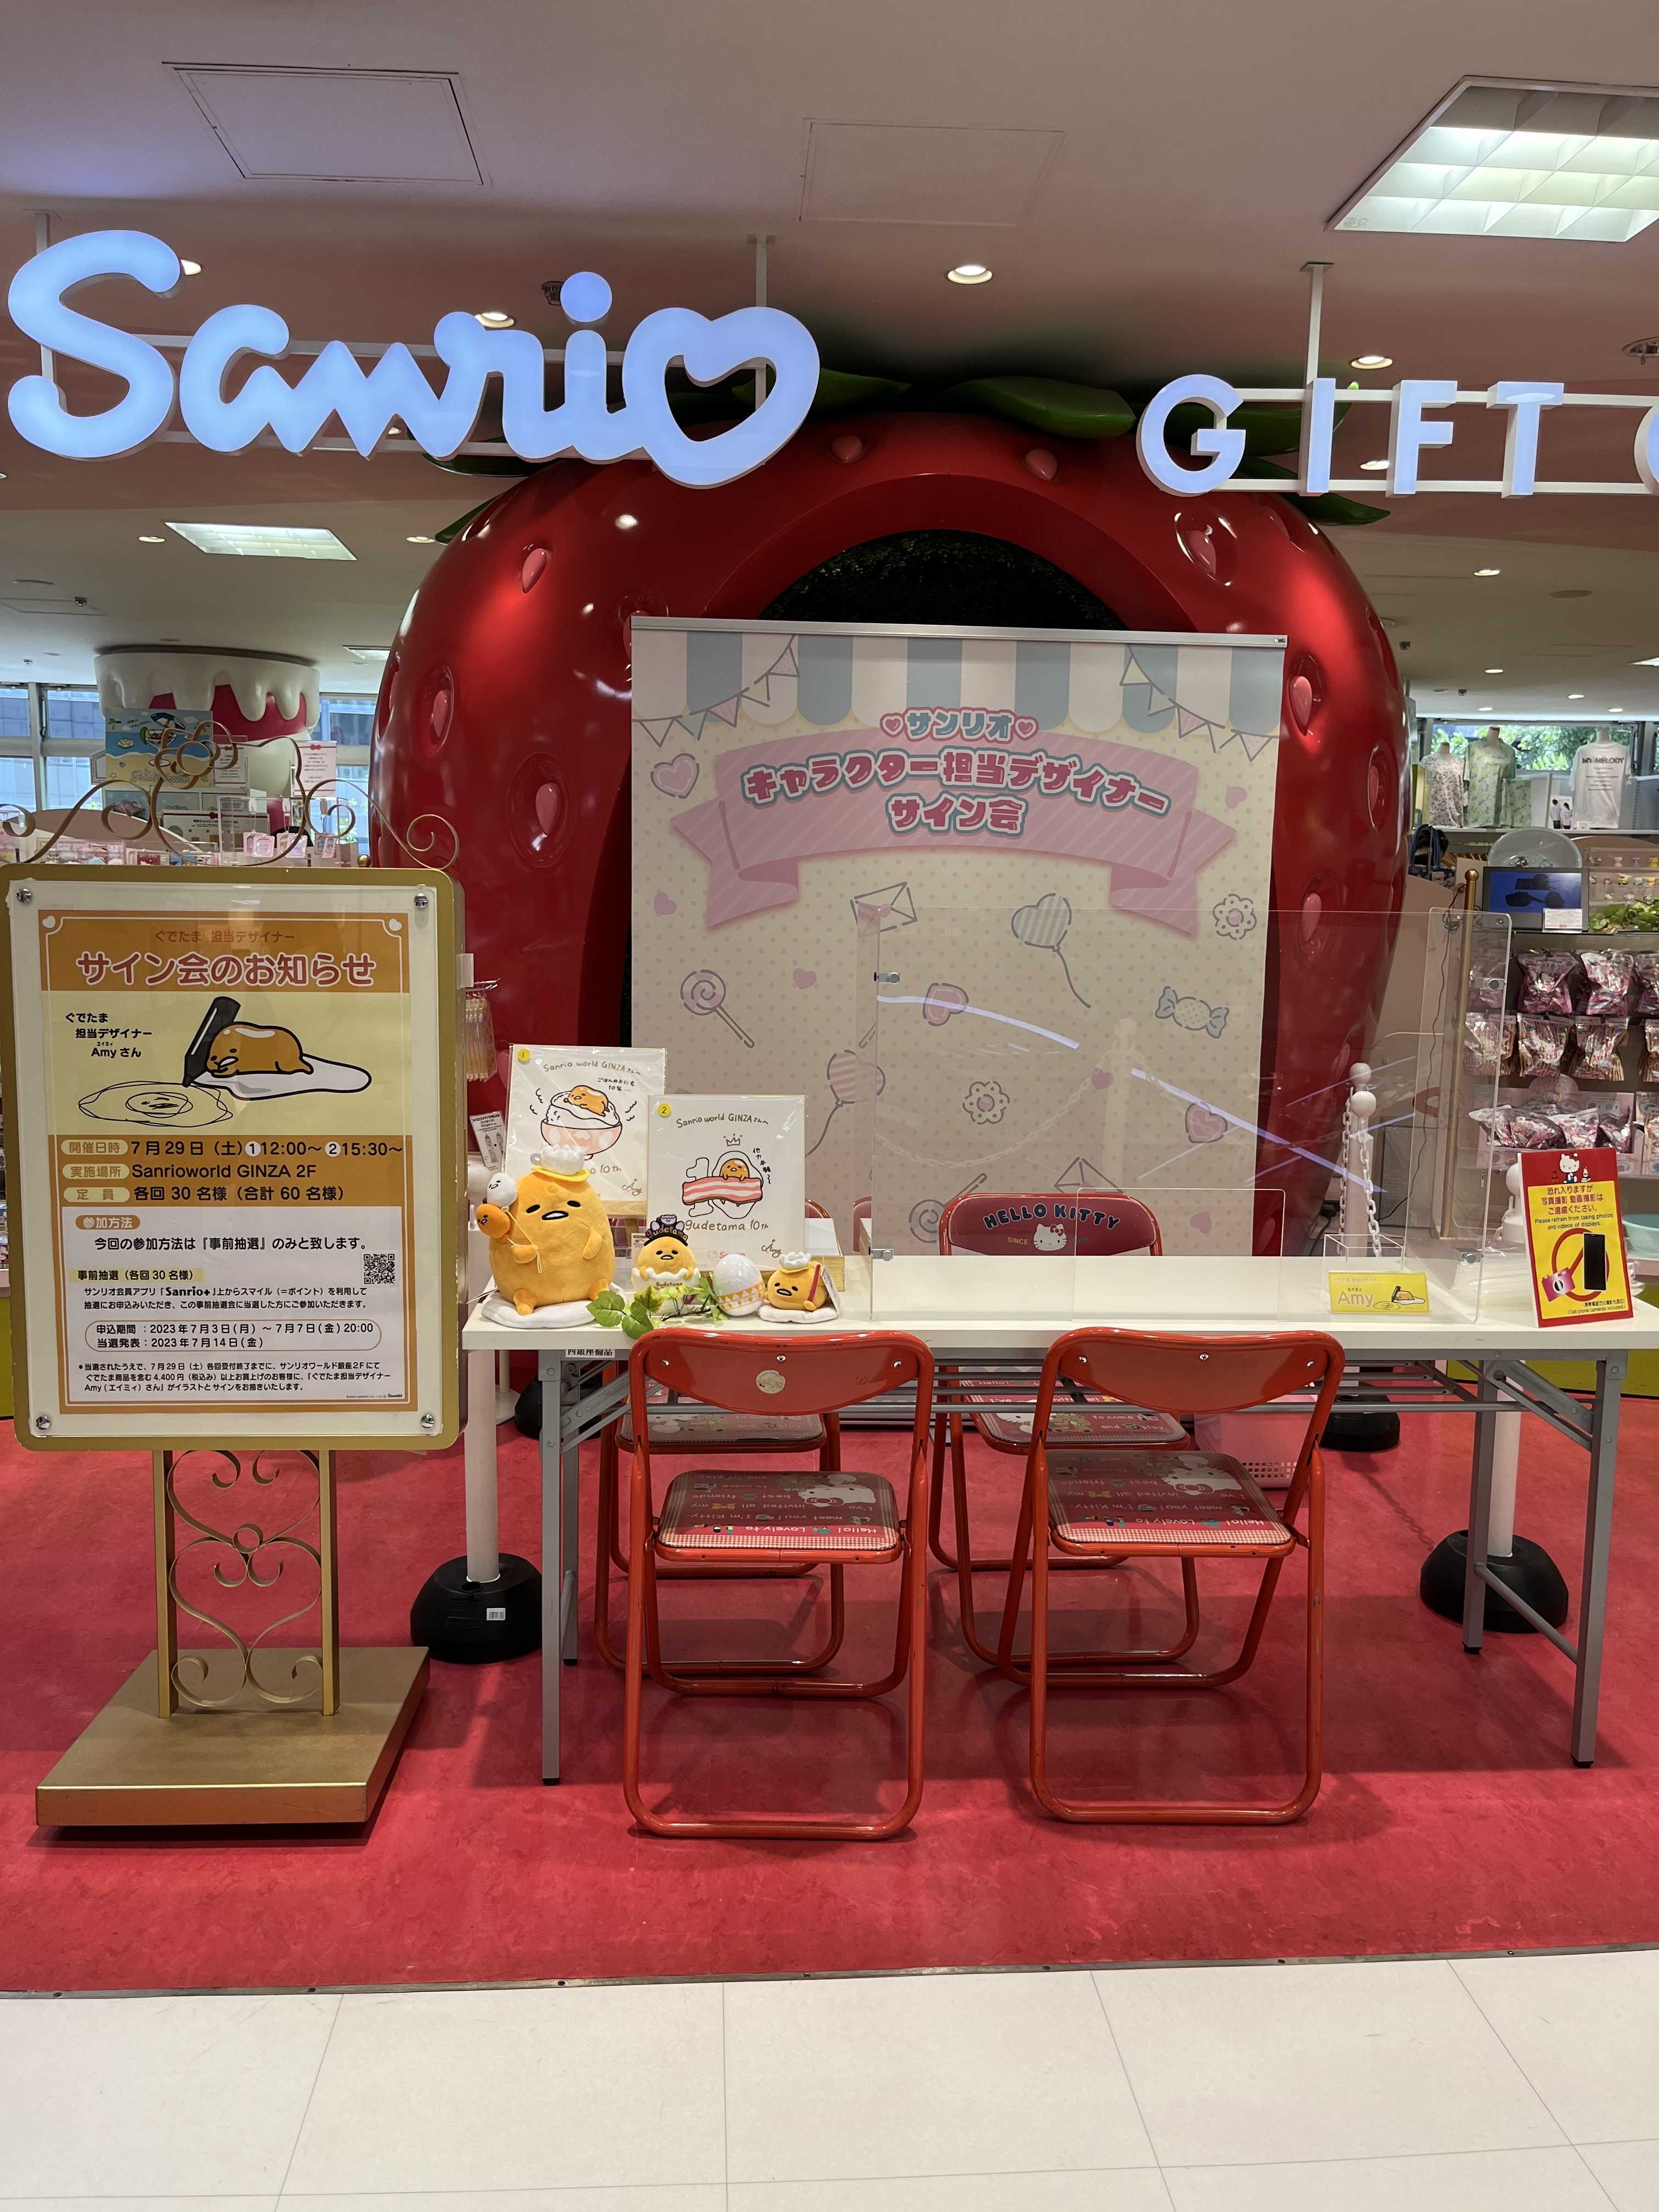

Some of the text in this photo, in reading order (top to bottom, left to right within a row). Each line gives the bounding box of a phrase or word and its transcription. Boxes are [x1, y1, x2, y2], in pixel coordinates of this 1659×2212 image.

[8, 229, 821, 489] Sanrio
[1137, 373, 1564, 498] GIFT
[905, 708, 1014, 740] サンリオ
[743, 748, 1170, 814] キャラクター担当デザイナー
[888, 793, 1027, 833] サイン会
[155, 930, 295, 943] ぐでたま 担当デザイナー
[77, 952, 376, 986] サイン会のお知らせ
[65, 1013, 109, 1024] ぐでたま
[75, 1028, 153, 1039] 担当デザイナー
[91, 1047, 141, 1058] Amy さん
[543, 1062, 573, 1072] Sanrio
[602, 1061, 625, 1072] GINZA
[676, 1117, 703, 1128] Sanrio
[704, 1113, 724, 1122] world
[729, 1113, 753, 1123] GINZA
[69, 1141, 120, 1154] 開催日時
[70, 1166, 121, 1178] 実施場所
[132, 1164, 317, 1178] Sanrioworld GINZA 2F
[1547, 1184, 1593, 1195] 恐れ入りますが
[83, 1216, 133, 1229] 参加方法
[983, 1203, 1120, 1229] HELLO KITTY
[686, 1220, 746, 1231] gudetama
[646, 1224, 688, 1242] gudetama
[1007, 1237, 1029, 1245] SINCE
[1338, 1290, 1374, 1307] Amy
